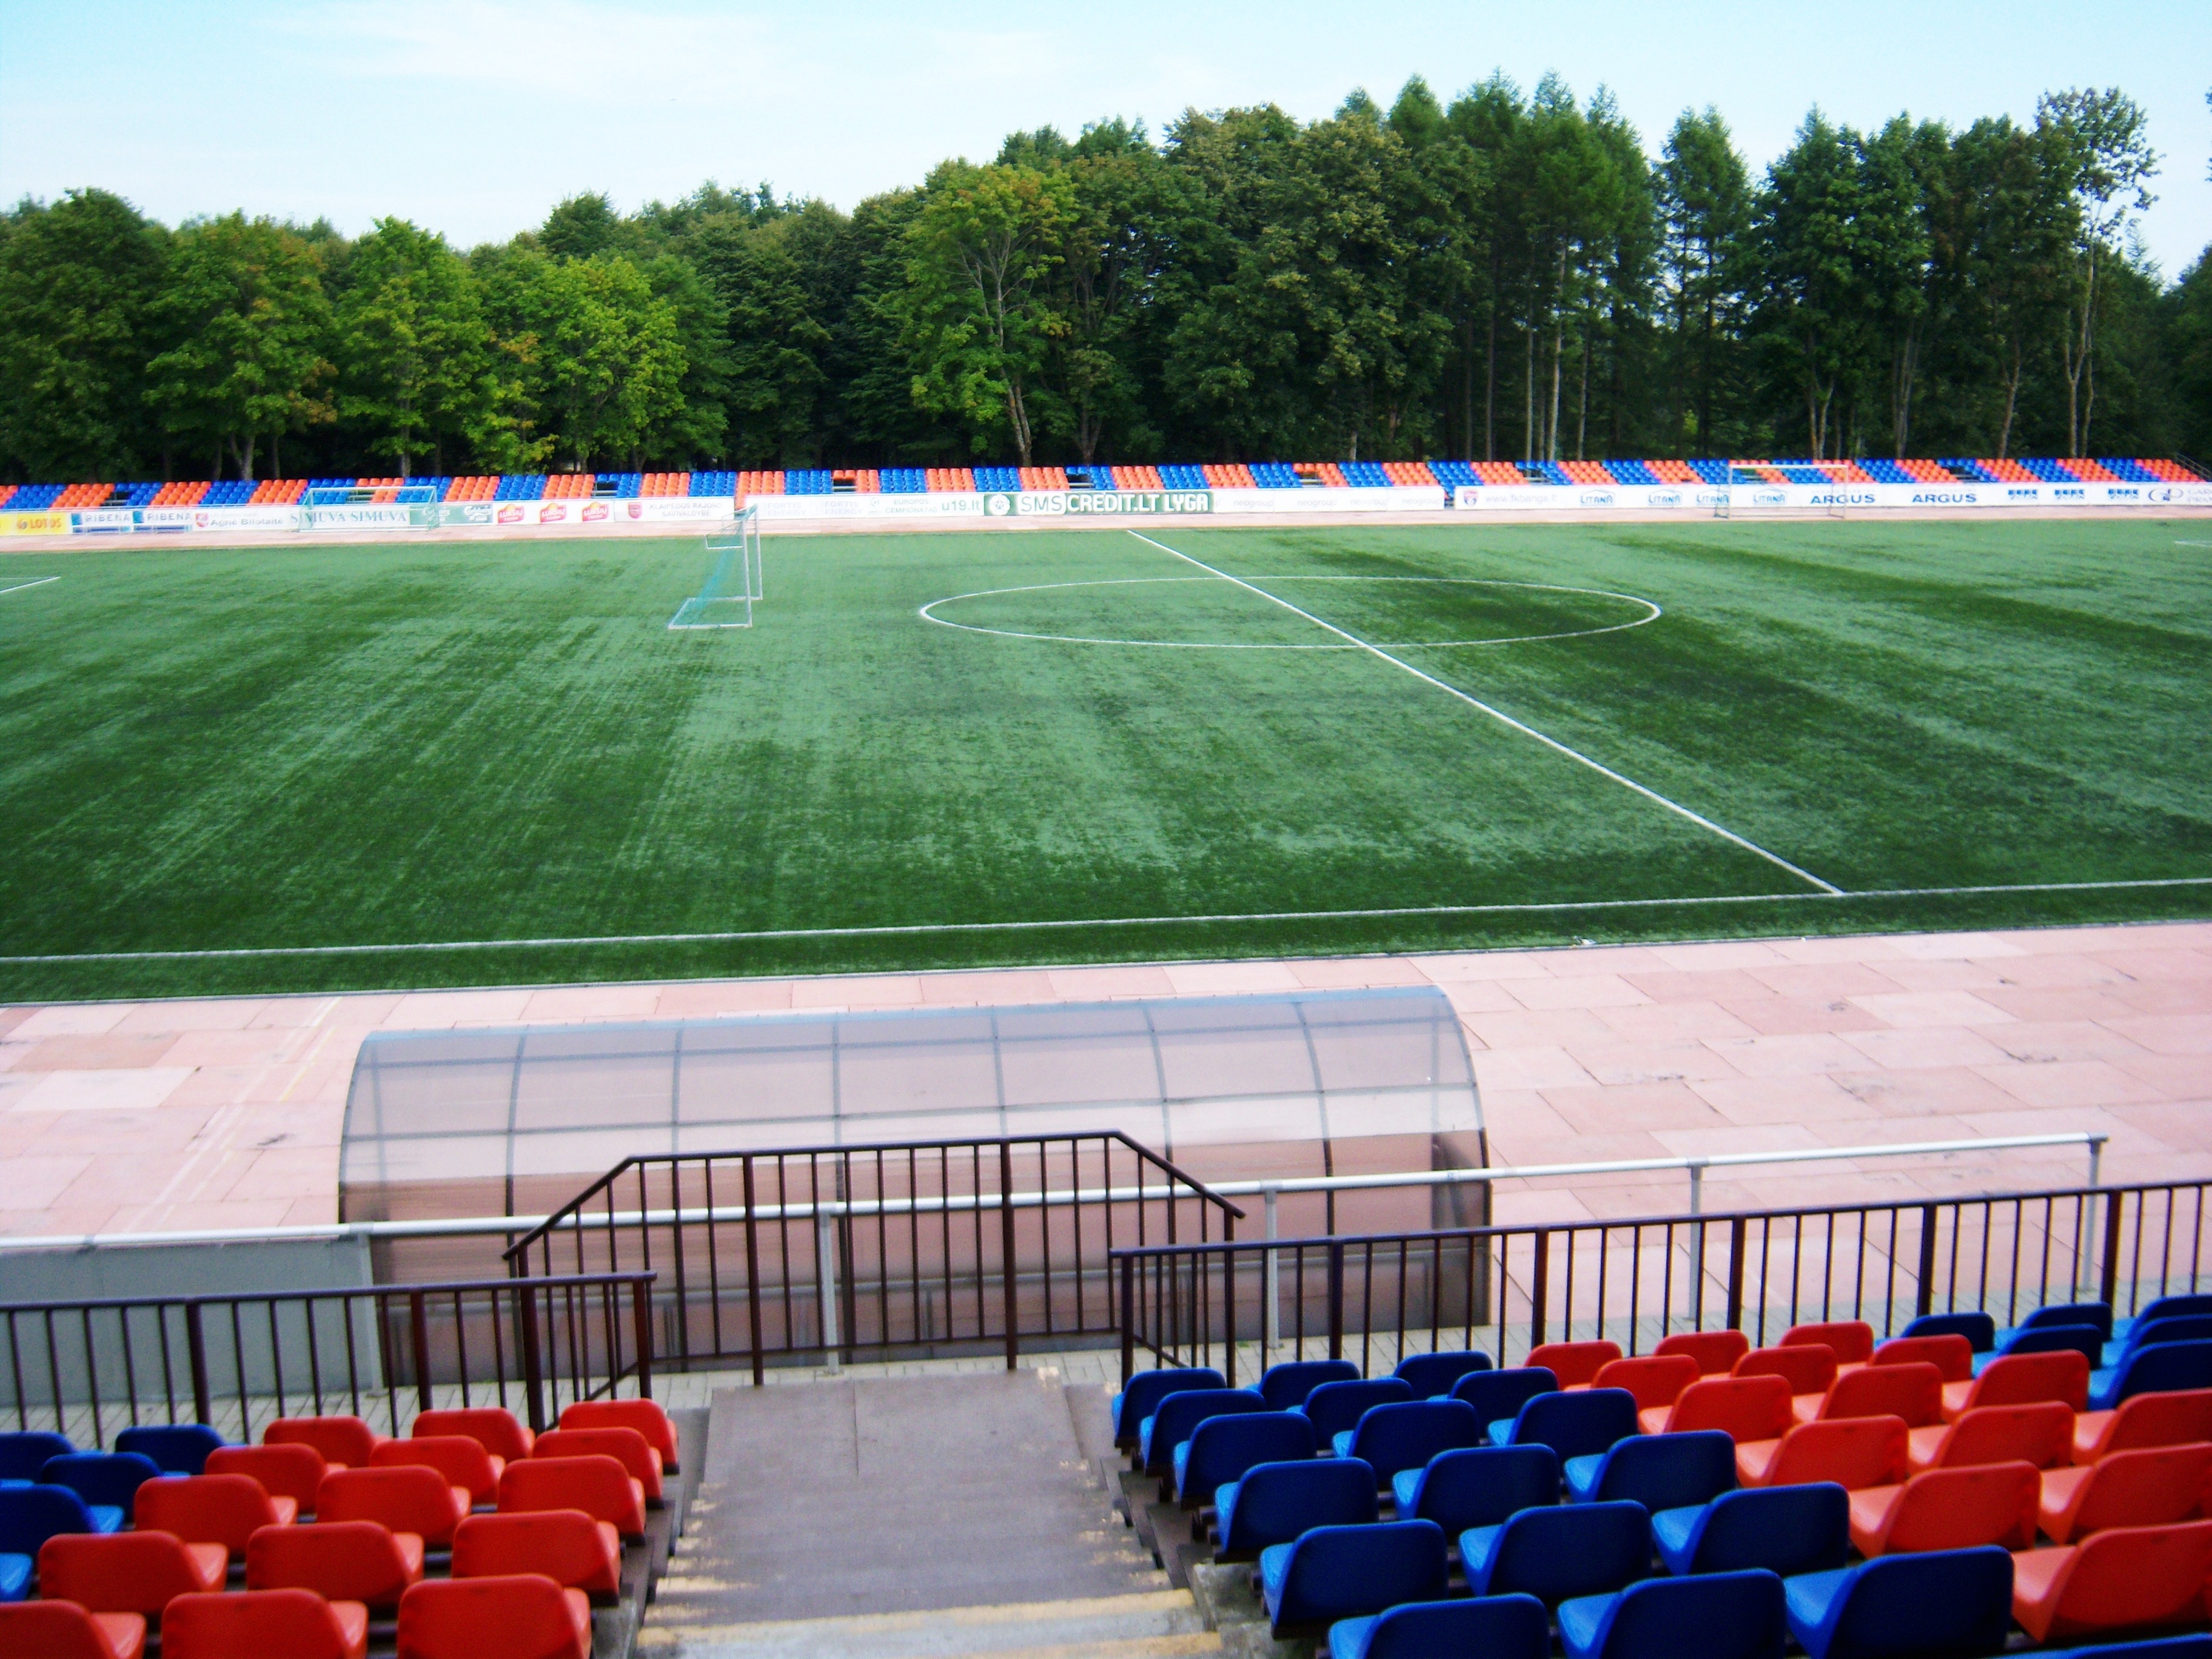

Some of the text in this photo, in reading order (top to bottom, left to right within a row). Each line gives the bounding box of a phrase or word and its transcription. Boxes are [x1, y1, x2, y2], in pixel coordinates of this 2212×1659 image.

[1021, 495, 1063, 512] SMS
[1067, 494, 1160, 512] CREDIT.LT
[1164, 494, 1208, 511] LYGA
[1810, 494, 1875, 504] ARGUS
[1911, 493, 1977, 503] ARGUS
[942, 499, 980, 511] u19.lt
[350, 511, 407, 522] SIMUVA
